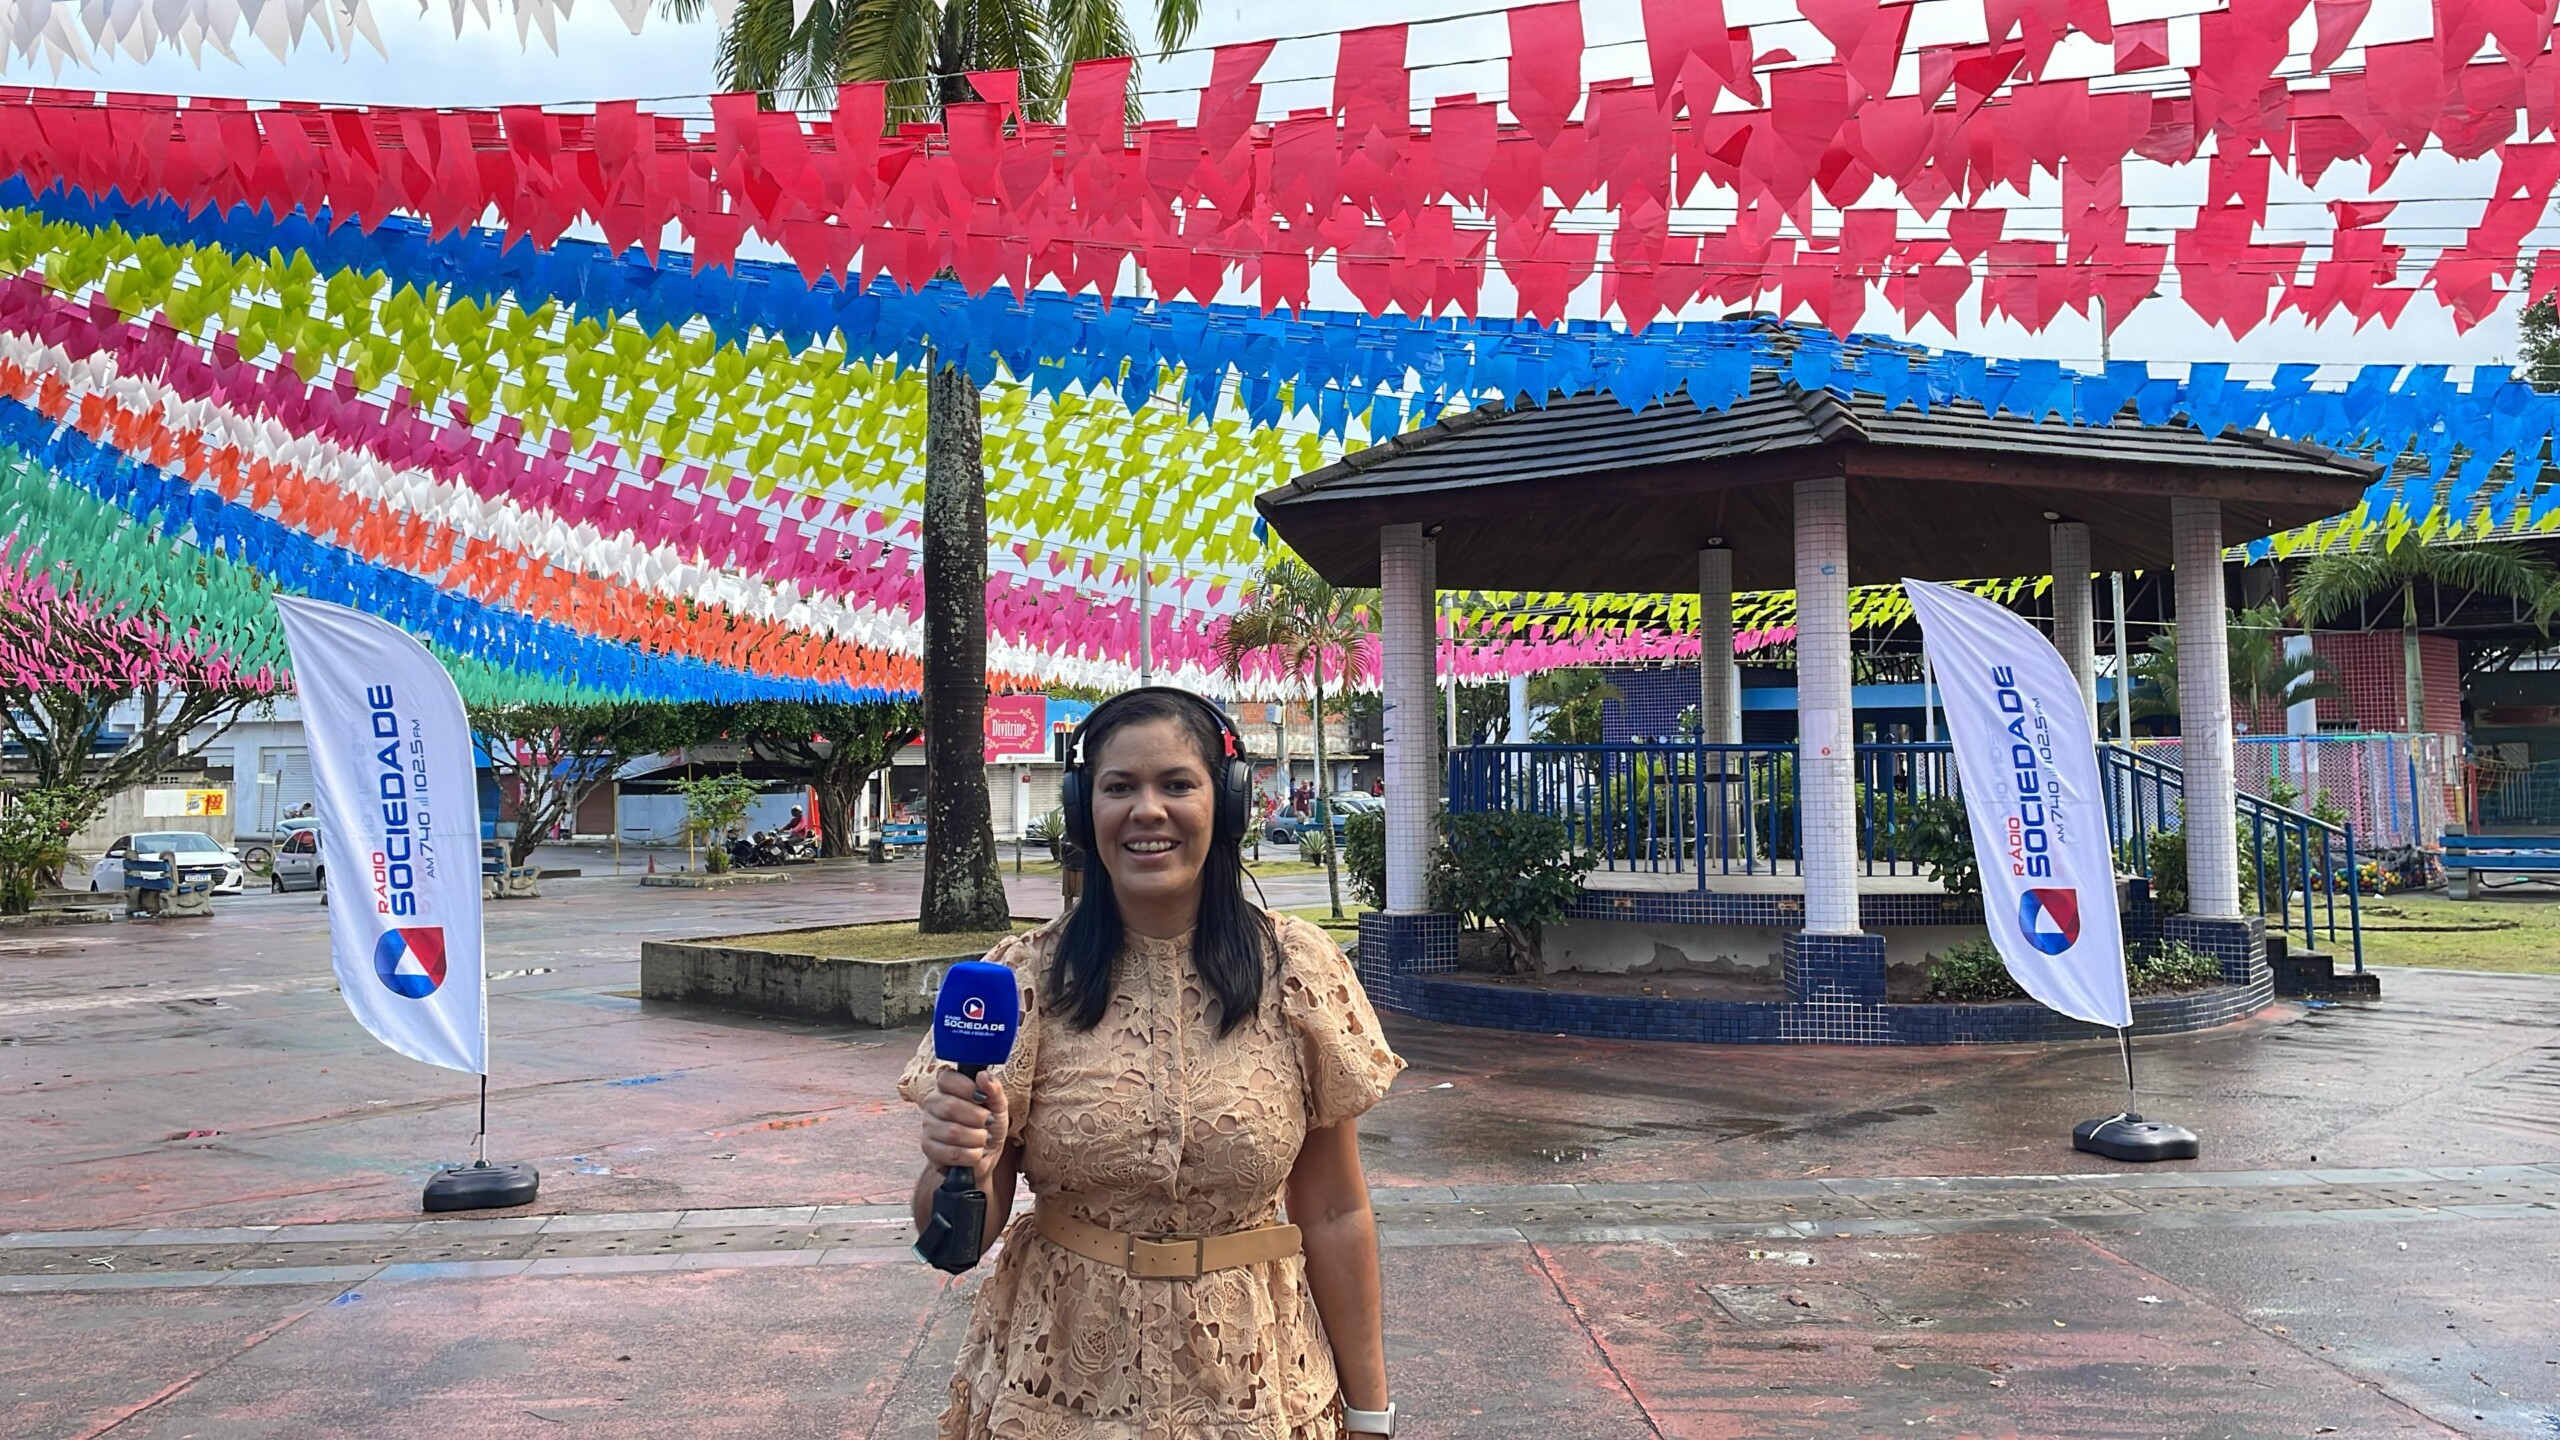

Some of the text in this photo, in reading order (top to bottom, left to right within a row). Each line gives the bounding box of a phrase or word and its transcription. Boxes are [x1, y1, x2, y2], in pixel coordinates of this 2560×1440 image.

[992, 719, 1027, 737] Divitrine
[1991, 666, 2052, 878] SOCIEDADE
[367, 684, 417, 916] SOCIEDADE
[2048, 781, 2063, 823] 740
[418, 812, 434, 856] 740
[2008, 817, 2025, 877] RÁDIO
[2058, 823, 2066, 843] AM
[372, 852, 390, 914] RÁDIO
[426, 857, 436, 878] AM
[944, 1019, 1005, 1032] SOCIEDADE
